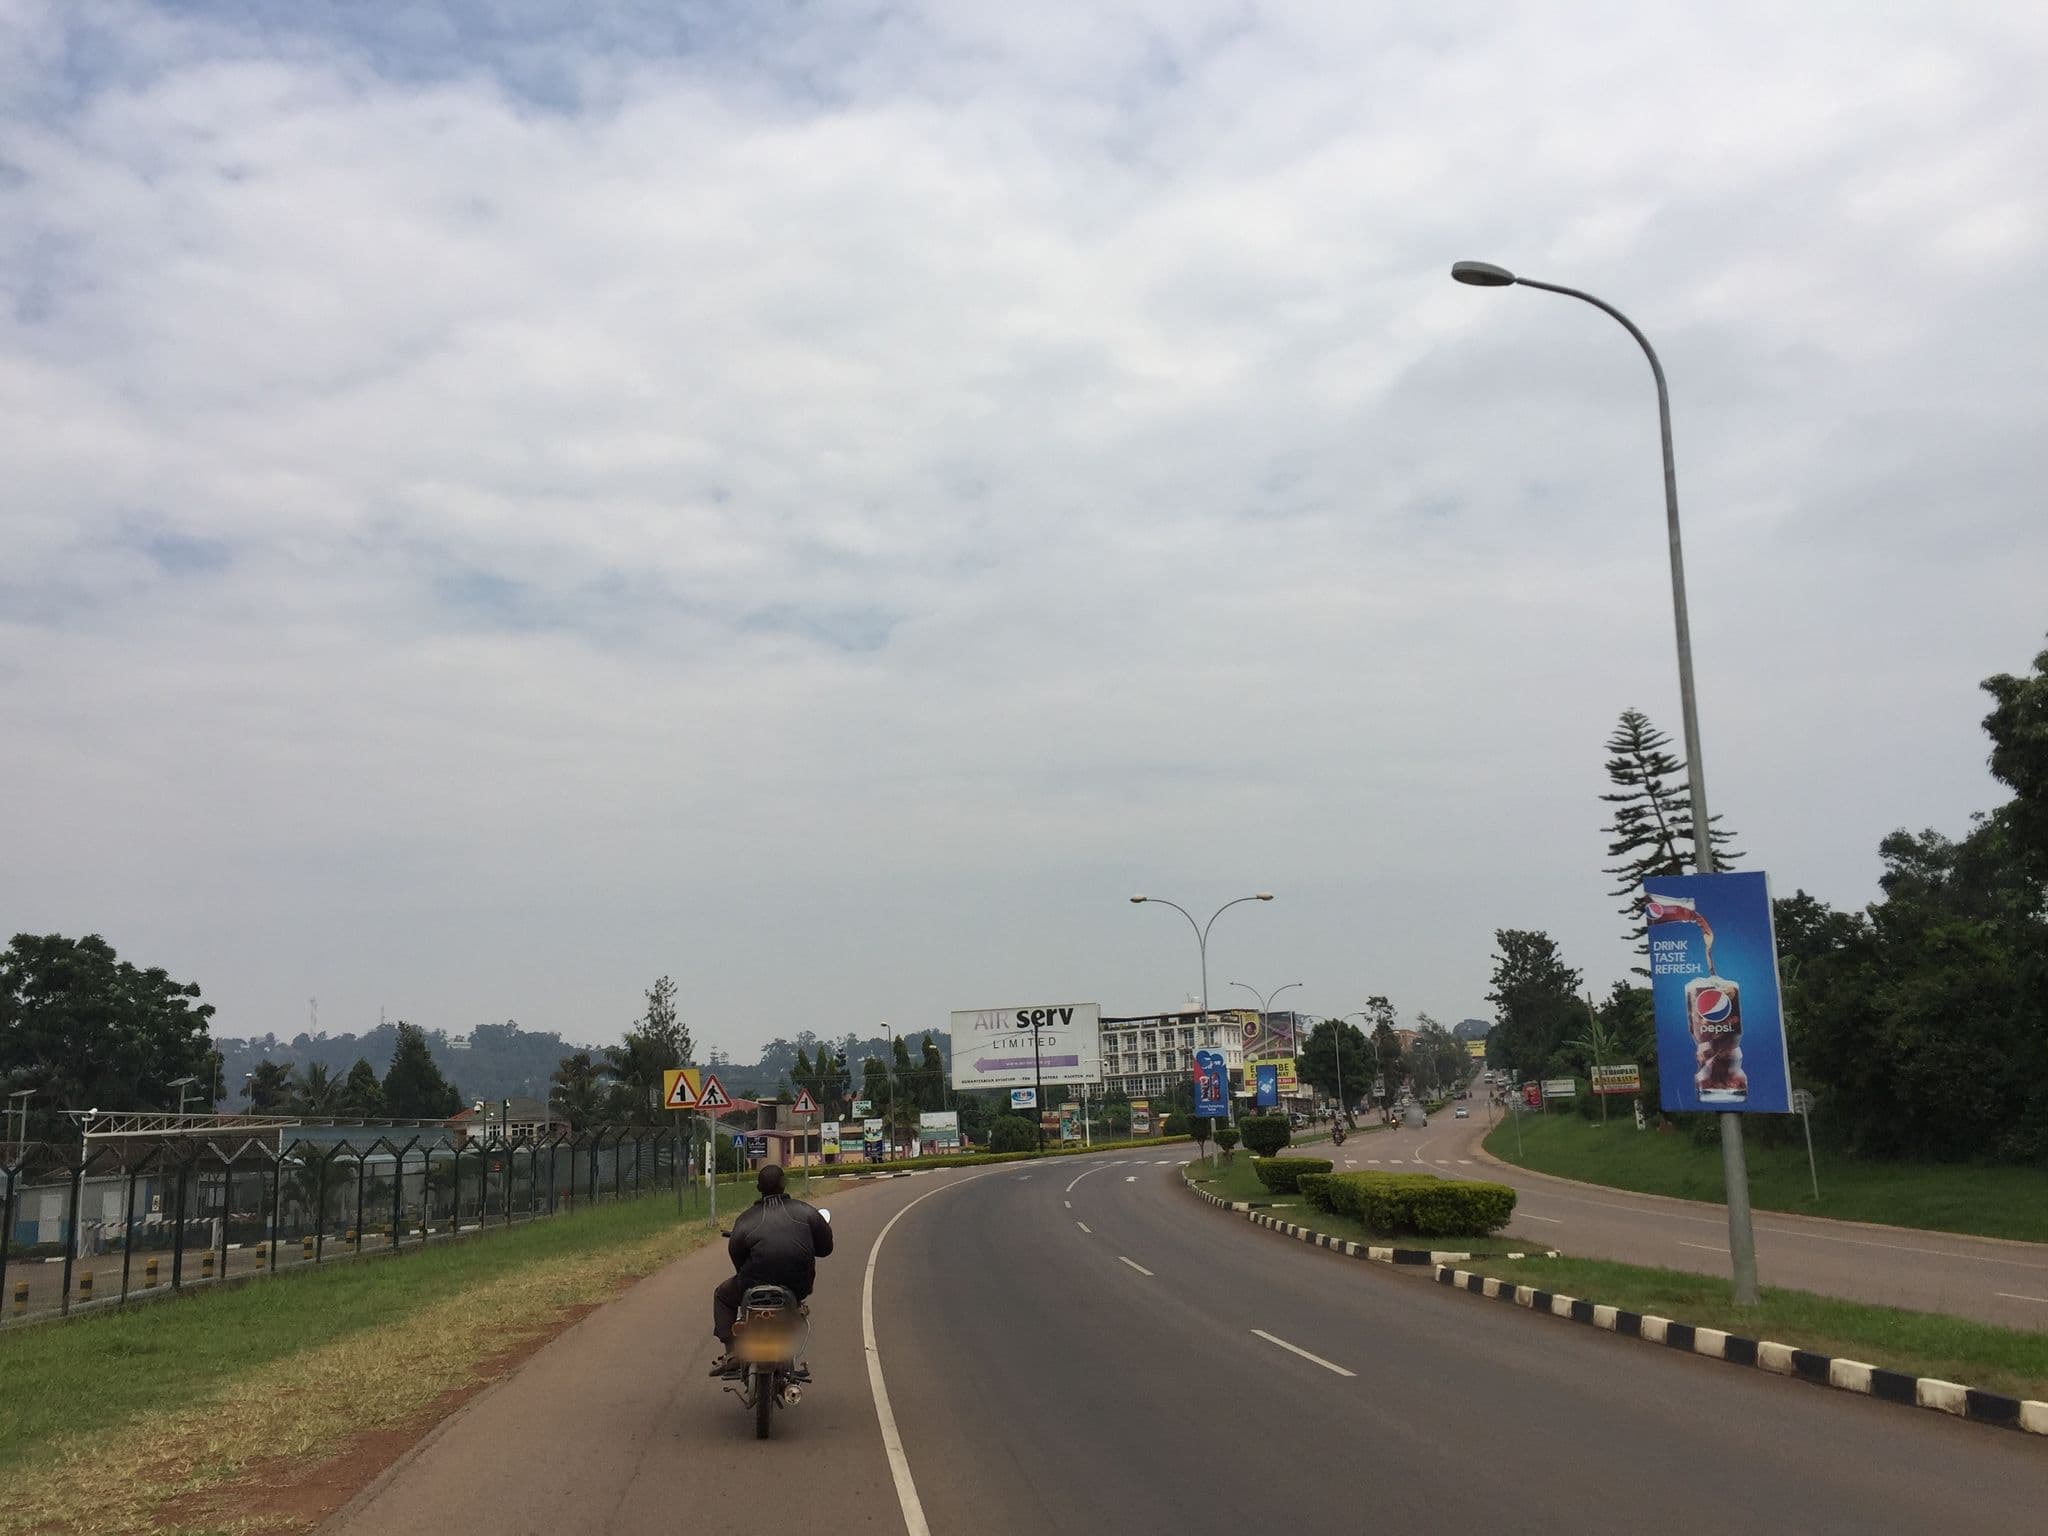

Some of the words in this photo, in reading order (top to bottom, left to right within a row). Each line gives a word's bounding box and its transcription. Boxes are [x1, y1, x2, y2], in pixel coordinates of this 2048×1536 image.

[1653, 940, 1689, 951] DRINK
[1654, 951, 1687, 963] TASTE
[974, 1011, 1010, 1031] AIR
[1016, 1007, 1074, 1029] serv
[1700, 1022, 1733, 1035] pepsi
[993, 1037, 1057, 1049] LIMITED
